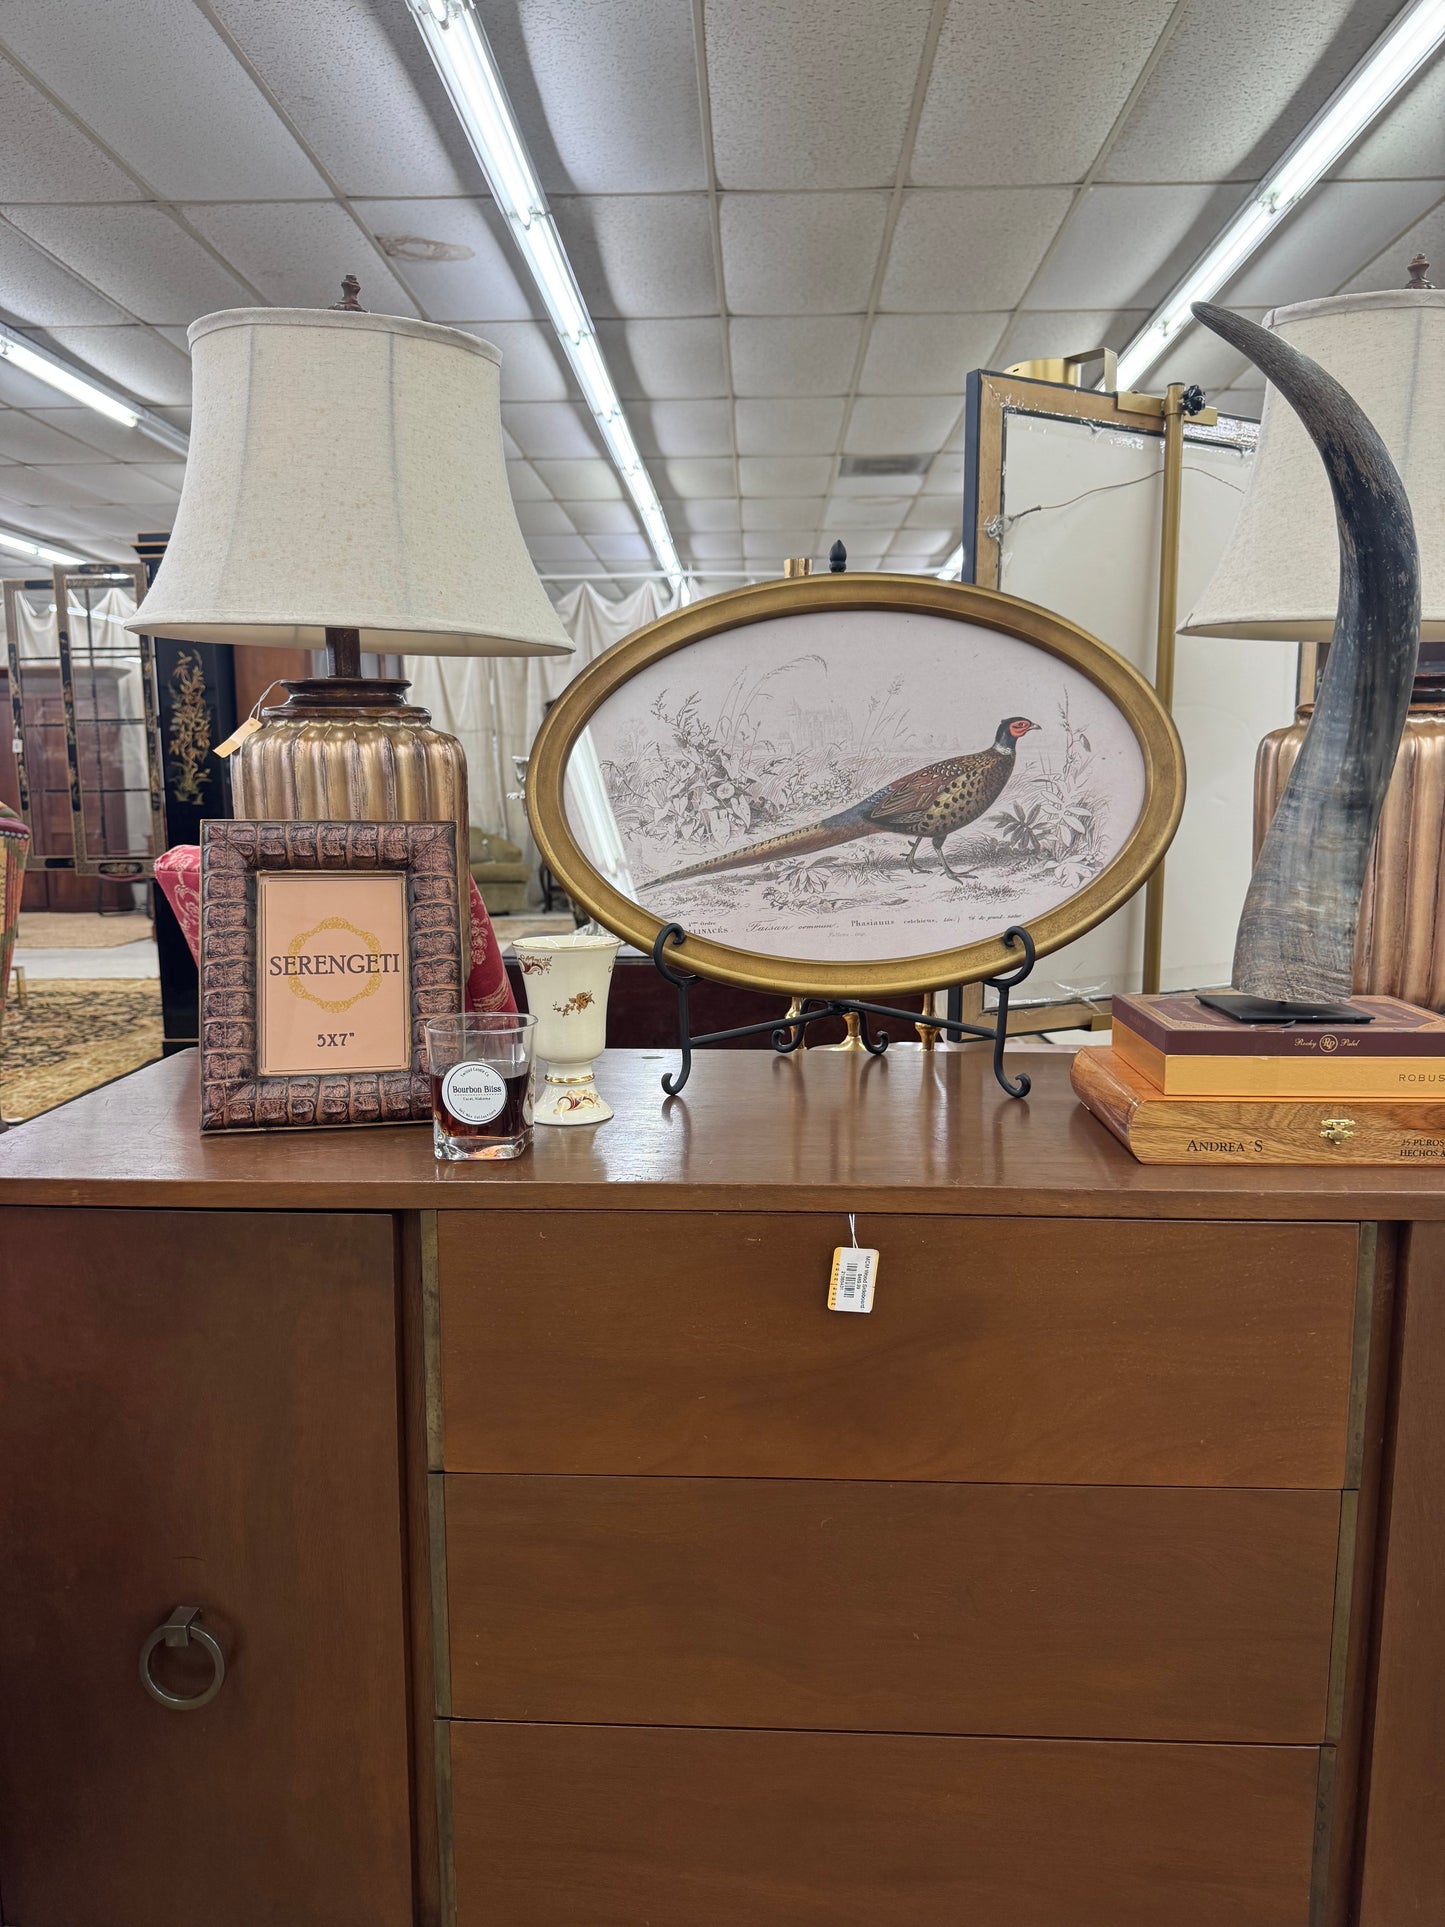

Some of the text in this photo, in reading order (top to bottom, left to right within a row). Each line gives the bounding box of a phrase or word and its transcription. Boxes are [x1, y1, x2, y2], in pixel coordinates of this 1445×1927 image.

[269, 953, 400, 976] SERENGETI
[1399, 1074, 1445, 1082] ROBUS
[452, 1085, 482, 1094] Bourbon
[1413, 1138, 1445, 1147] PUROS
[1400, 1149, 1438, 1157] HECHOS
[860, 1284, 868, 1309] Sideboard
